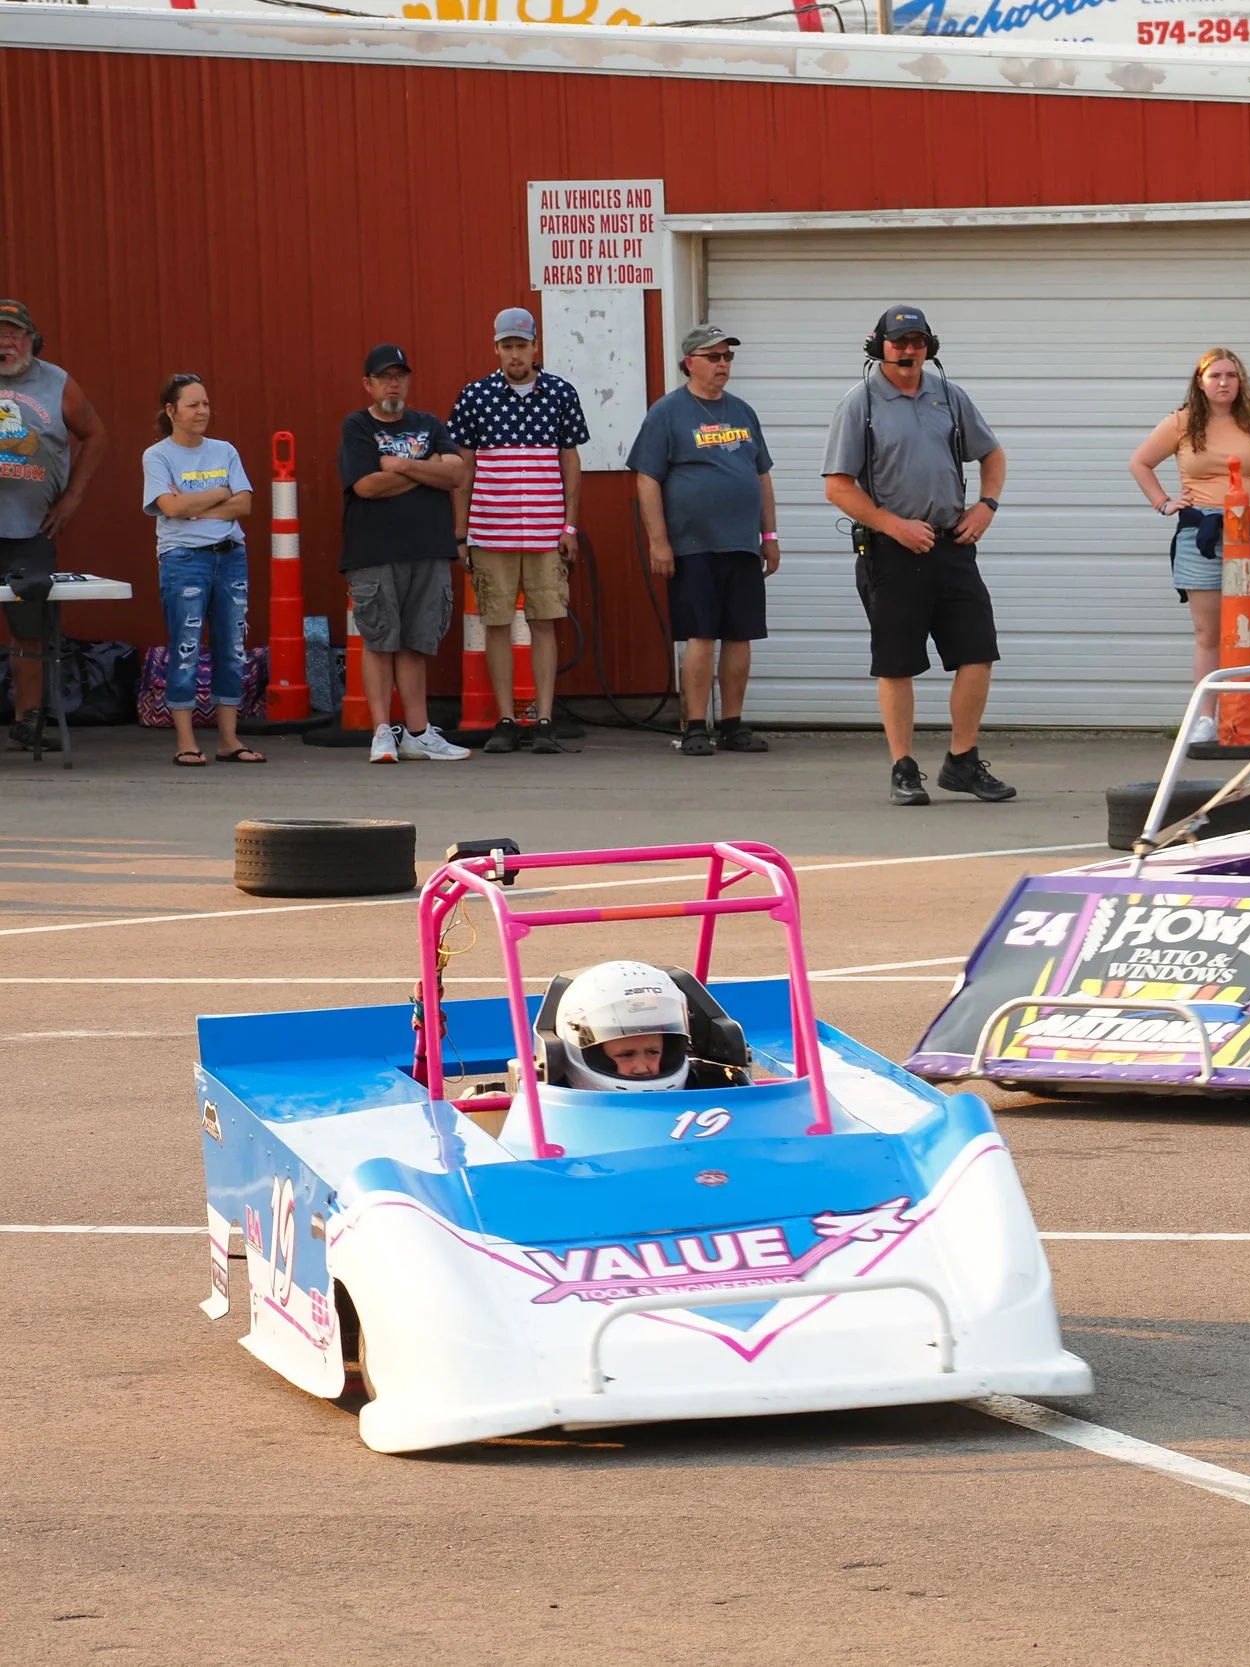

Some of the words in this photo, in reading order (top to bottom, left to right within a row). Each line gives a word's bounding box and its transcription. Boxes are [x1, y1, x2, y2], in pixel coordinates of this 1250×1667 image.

[564, 189, 621, 209] VEHICLES
[626, 188, 652, 209] AND
[540, 214, 596, 235] PATRONS
[600, 213, 635, 234] MUST
[640, 213, 655, 233] BE
[552, 239, 575, 260] OUT
[579, 239, 593, 259] OF
[598, 239, 619, 259] ALL
[624, 238, 643, 258] PIT
[543, 265, 583, 285] AREAS
[587, 264, 603, 284] BY
[607, 264, 654, 284] 1:00am
[0, 462, 46, 481] EDOM
[1004, 908, 1081, 948] 24
[1127, 947, 1208, 966] PATIO
[1207, 953, 1236, 969] &
[1107, 962, 1238, 985] WINDOWS
[623, 985, 663, 997] zamp
[669, 1107, 734, 1141] 19
[269, 1172, 297, 1308] 19
[526, 1226, 793, 1284] VALUE
[578, 1286, 633, 1301] TOOL
